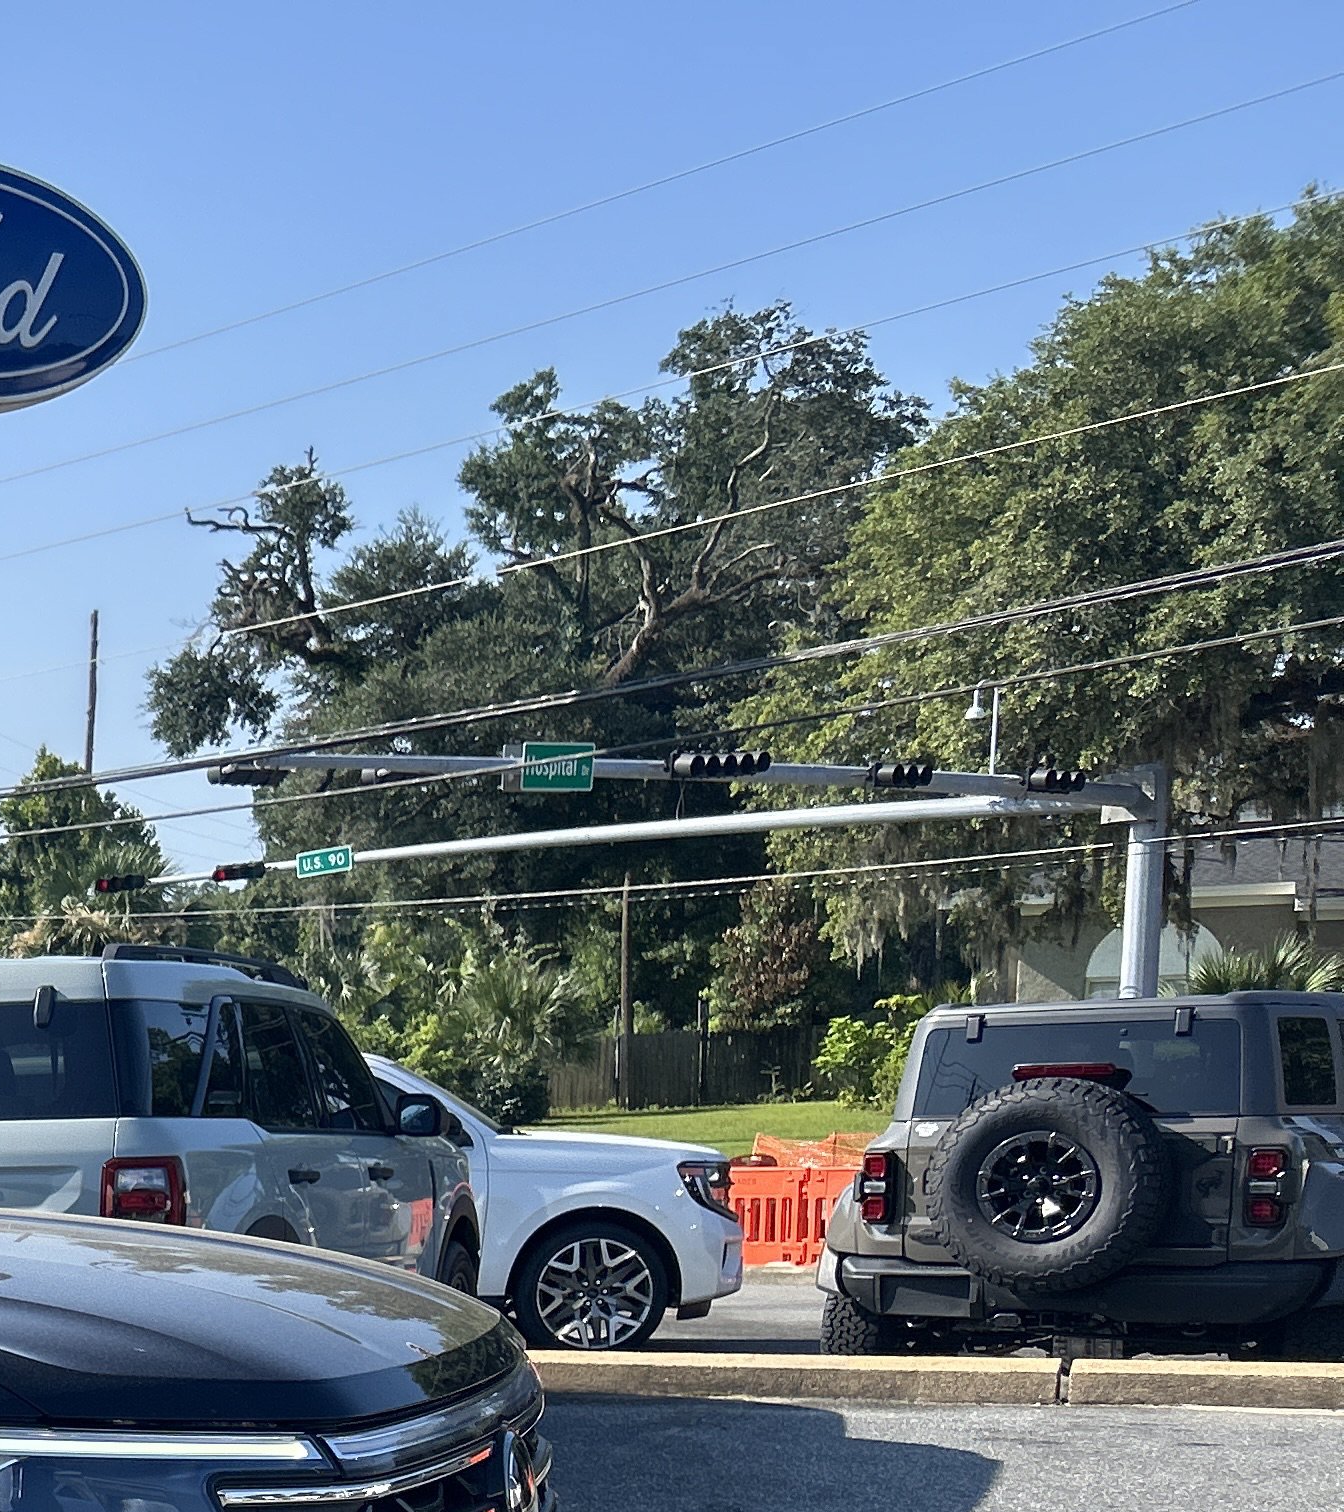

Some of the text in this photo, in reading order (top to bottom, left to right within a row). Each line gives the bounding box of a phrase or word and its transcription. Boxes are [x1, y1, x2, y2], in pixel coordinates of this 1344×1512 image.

[525, 755, 578, 781] Hospital
[302, 852, 345, 872] U.S. 90
